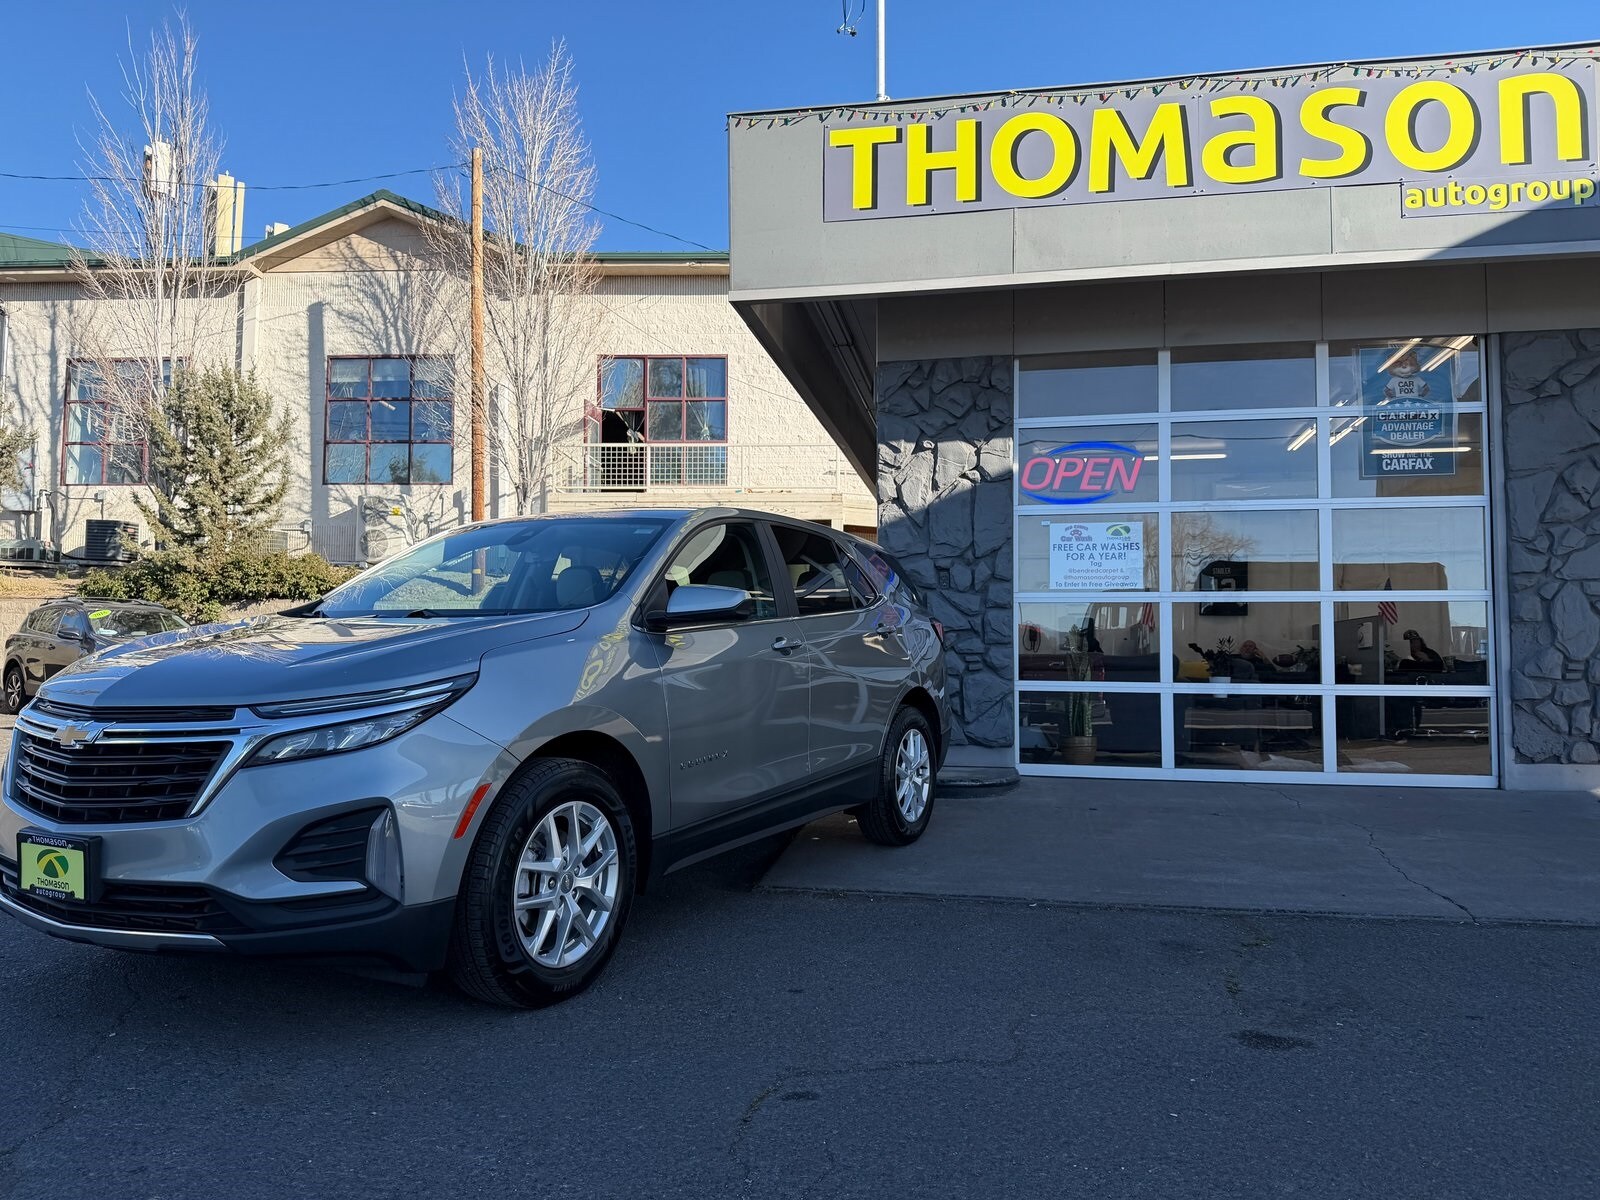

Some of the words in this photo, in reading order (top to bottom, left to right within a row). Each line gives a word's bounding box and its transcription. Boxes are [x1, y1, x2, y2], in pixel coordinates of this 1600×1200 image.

[1404, 178, 1596, 210] autogroup
[1378, 411, 1439, 421] CARFAX
[1381, 422, 1434, 432] ADVANTAGE
[1390, 431, 1425, 440] DEALER
[1382, 458, 1433, 470] CARFAX
[1021, 457, 1143, 491] OPEN
[1053, 543, 1074, 552] FREE
[1076, 543, 1097, 552] CAR
[1100, 542, 1140, 551] WASHES
[1066, 553, 1085, 561] FOR
[1099, 552, 1127, 560] YEAR!
[35, 888, 66, 899] autogroup
